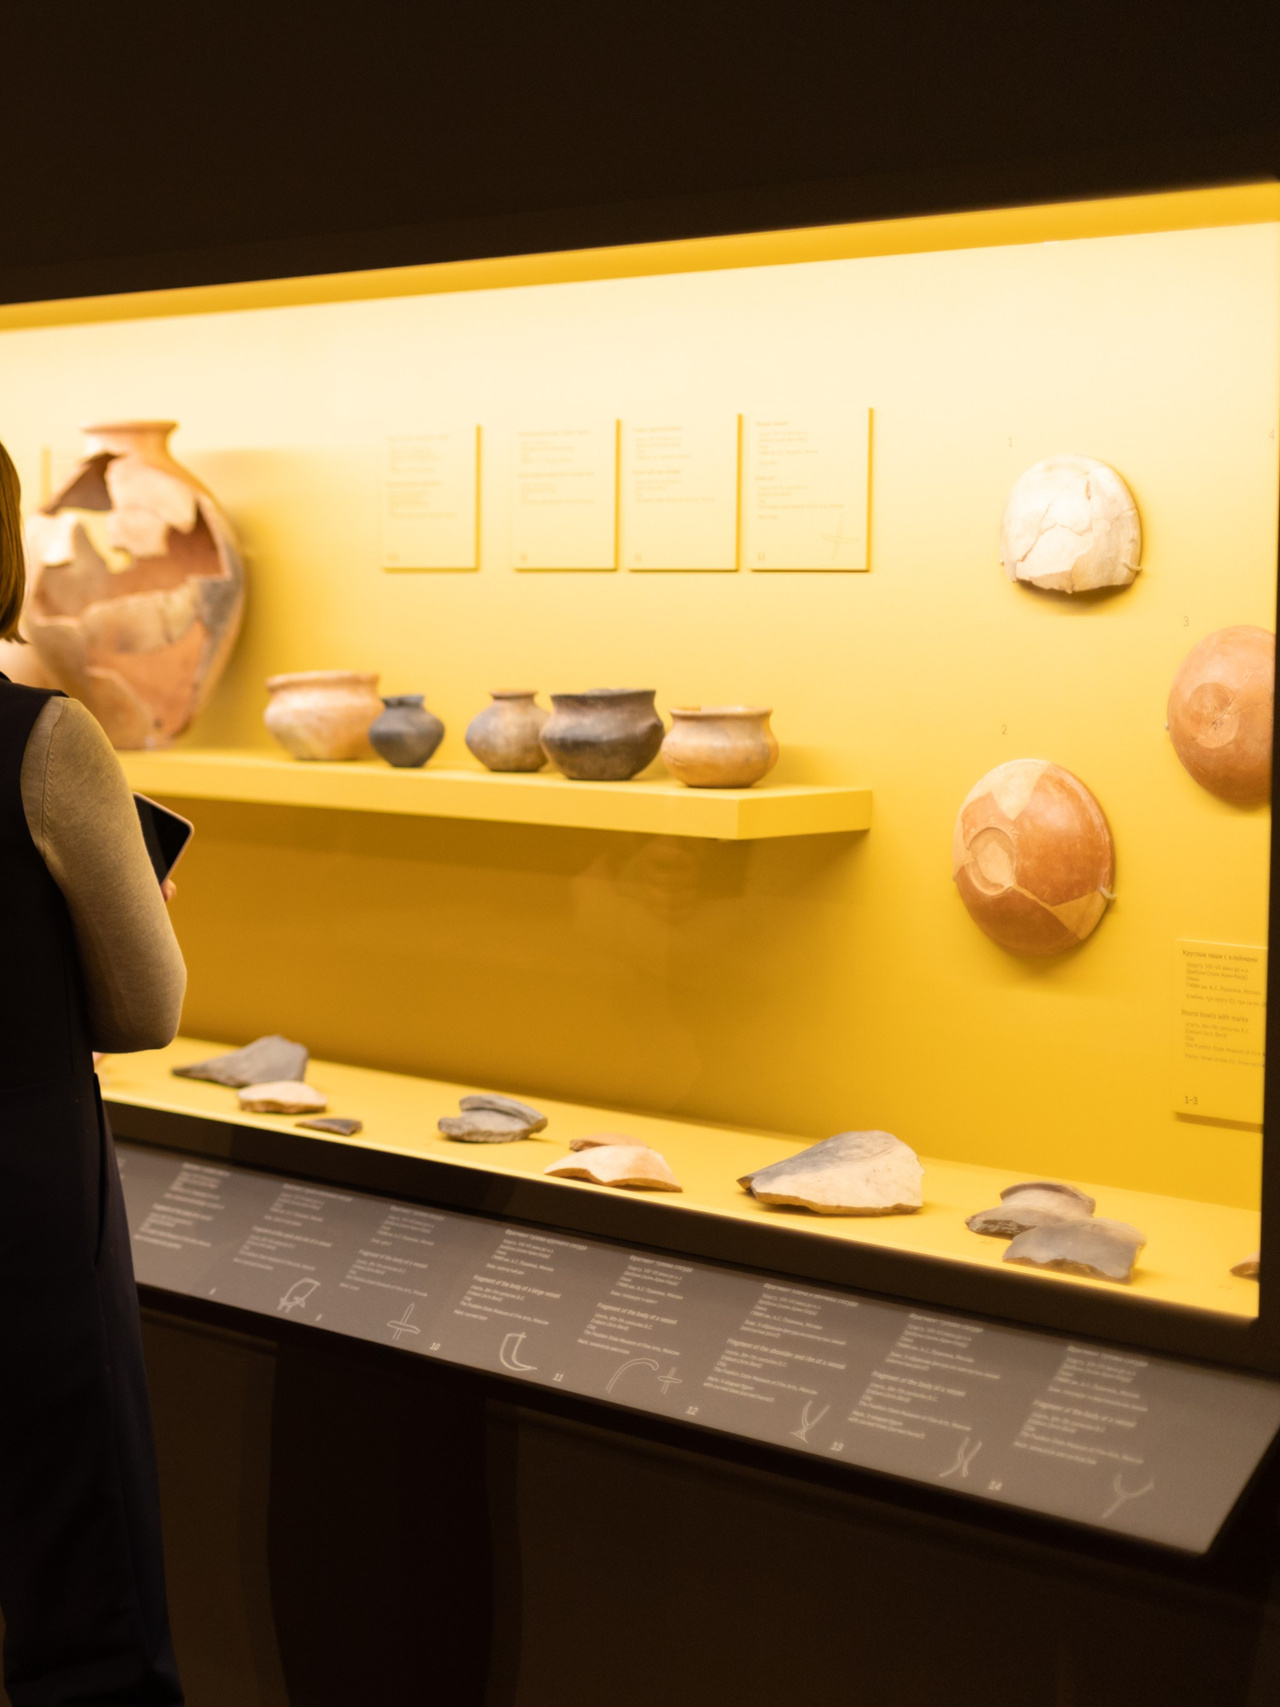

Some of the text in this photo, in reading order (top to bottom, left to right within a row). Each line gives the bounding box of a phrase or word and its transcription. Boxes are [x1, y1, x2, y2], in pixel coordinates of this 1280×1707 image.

[1183, 615, 1190, 627] 3
[1001, 723, 1008, 735] 2
[552, 1373, 564, 1382] 11
[686, 1406, 698, 1416] 12
